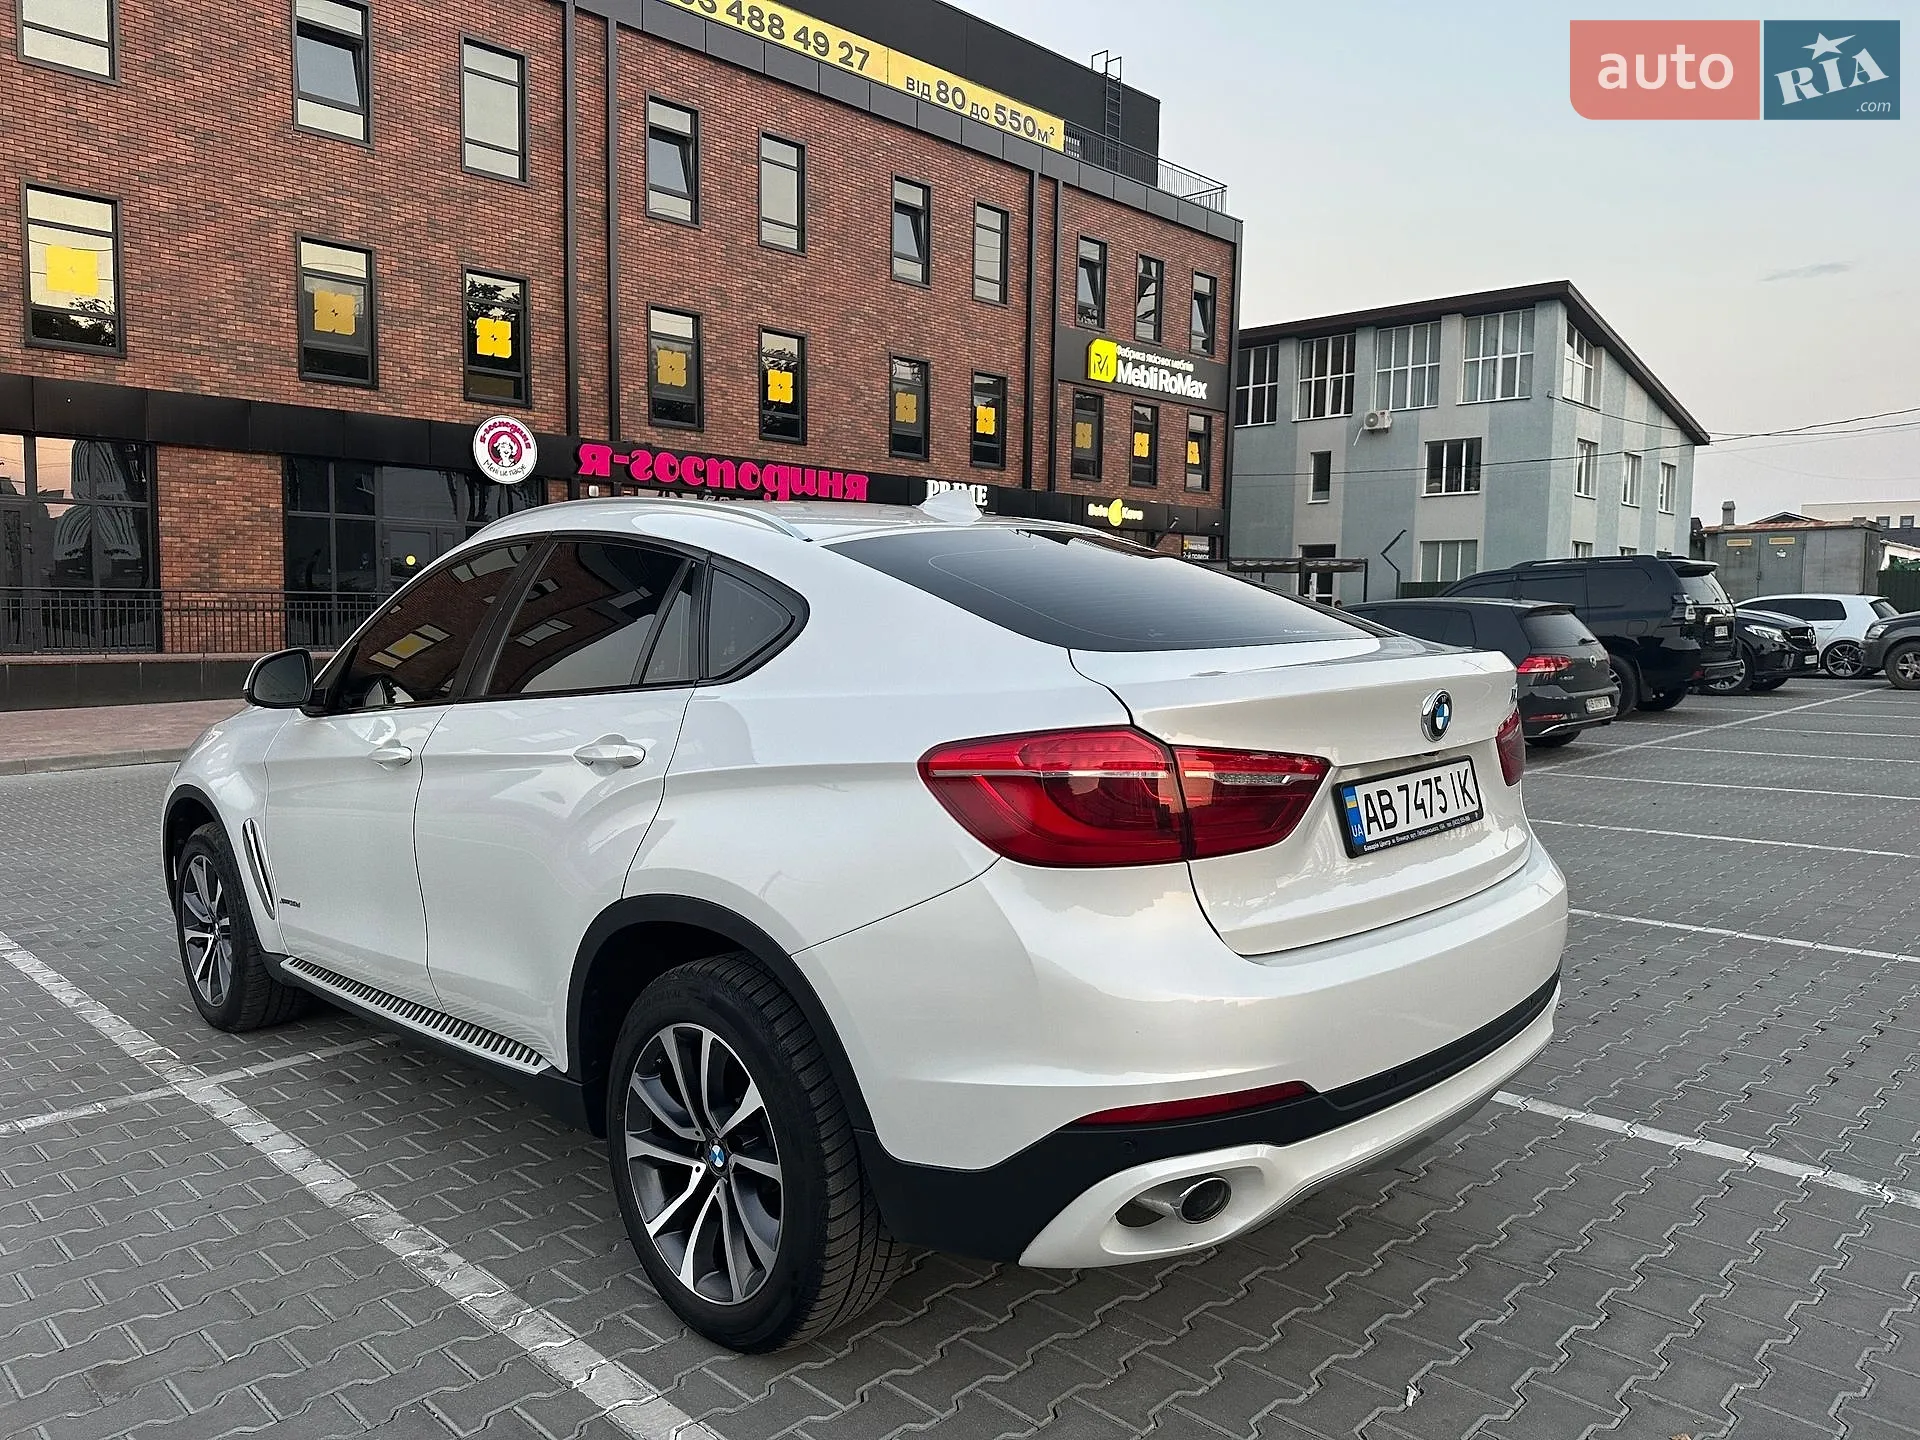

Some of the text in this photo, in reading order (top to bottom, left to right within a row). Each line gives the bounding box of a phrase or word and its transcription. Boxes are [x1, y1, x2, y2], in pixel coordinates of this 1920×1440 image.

[726, 0, 785, 39] 488
[794, 26, 829, 56] 49
[838, 41, 869, 71] 27
[936, 80, 965, 109] 80
[970, 102, 989, 120] до
[1364, 789, 1398, 835] AB
[1397, 775, 1448, 825] 7475
[1450, 768, 1476, 810] IK
[1351, 823, 1364, 838] UA
